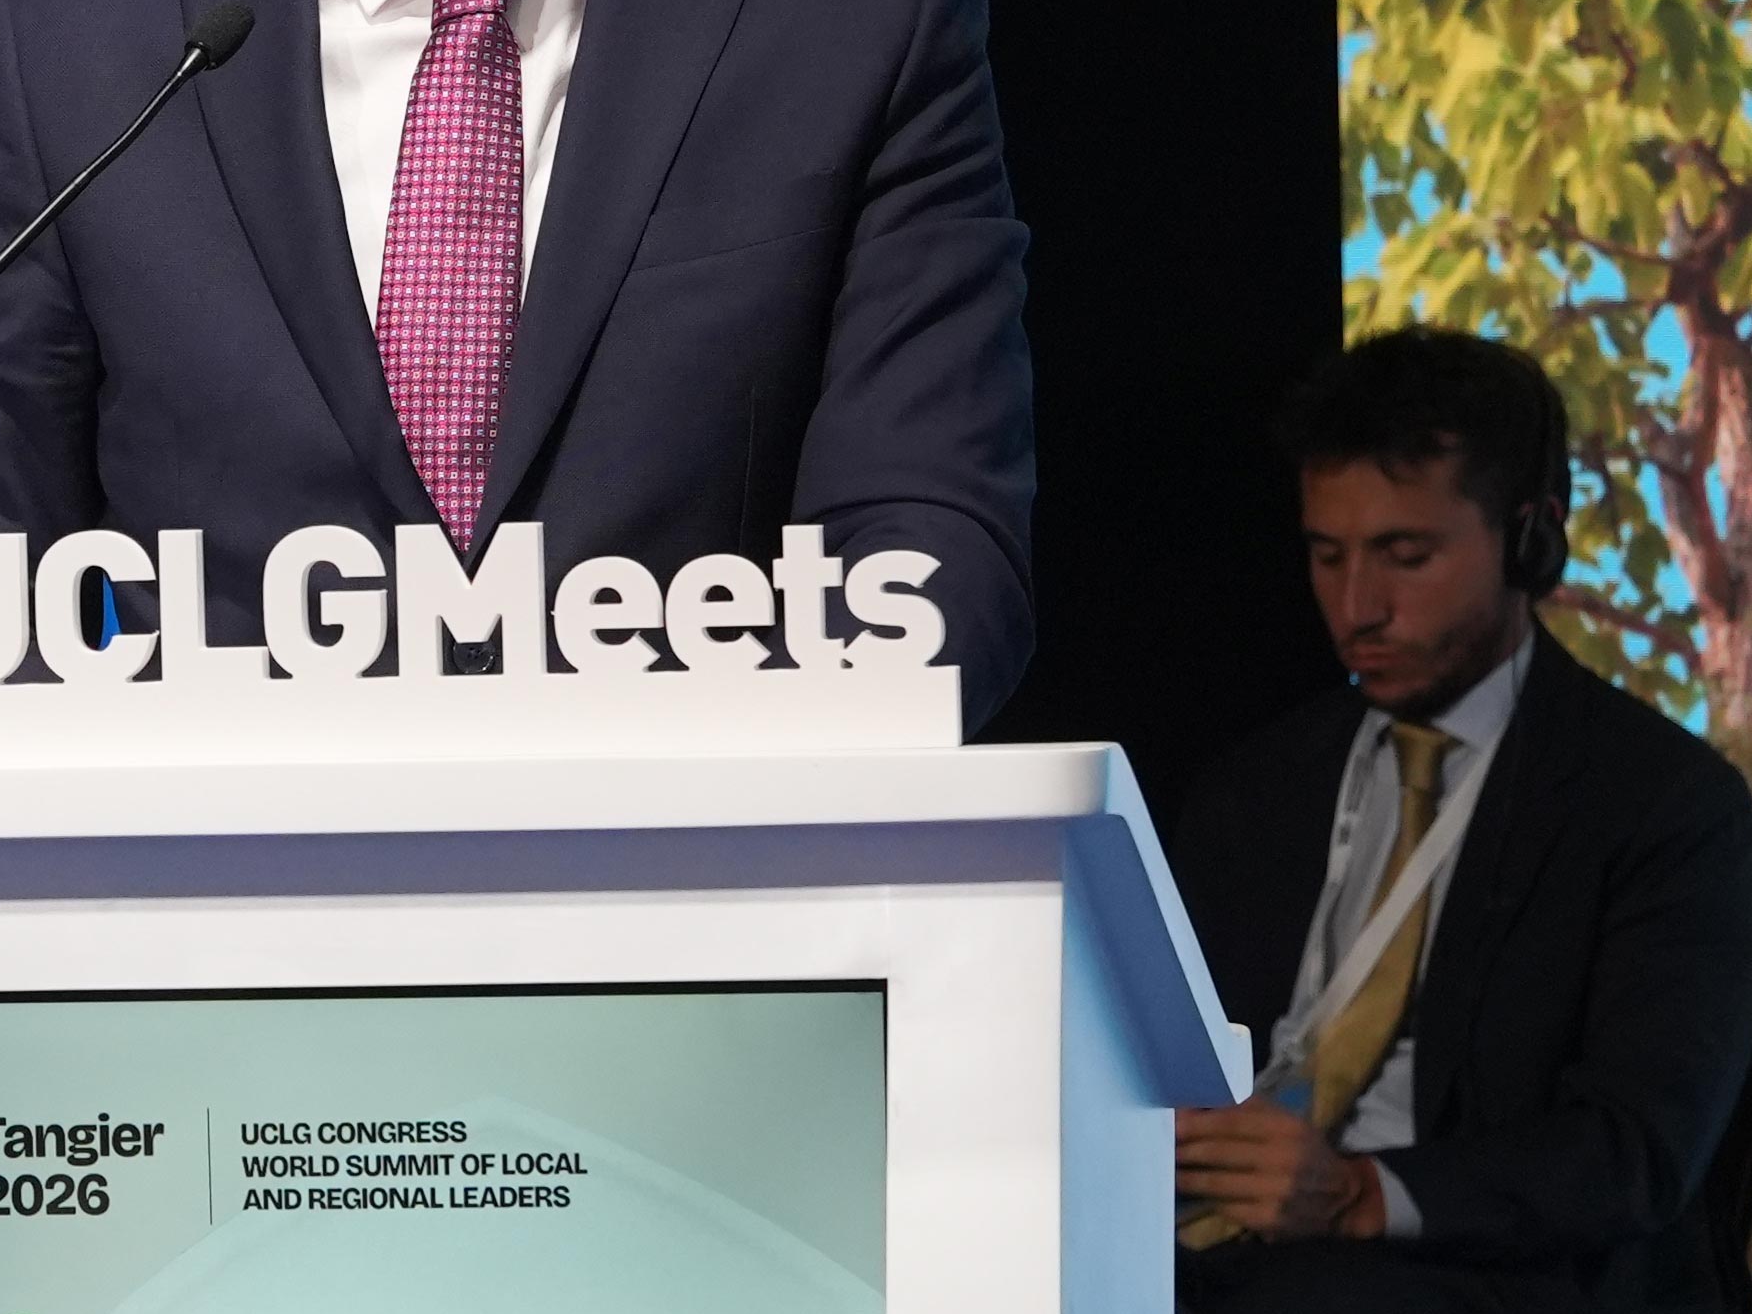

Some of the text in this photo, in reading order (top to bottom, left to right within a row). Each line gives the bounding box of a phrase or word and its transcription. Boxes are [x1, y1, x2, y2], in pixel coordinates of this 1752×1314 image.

[240, 1120, 468, 1145] UCLG CONGRESS
[242, 1152, 588, 1178] WORLD SUMMIT OF LOCAL
[243, 1185, 571, 1211] AND REGIONAL LEADERS
